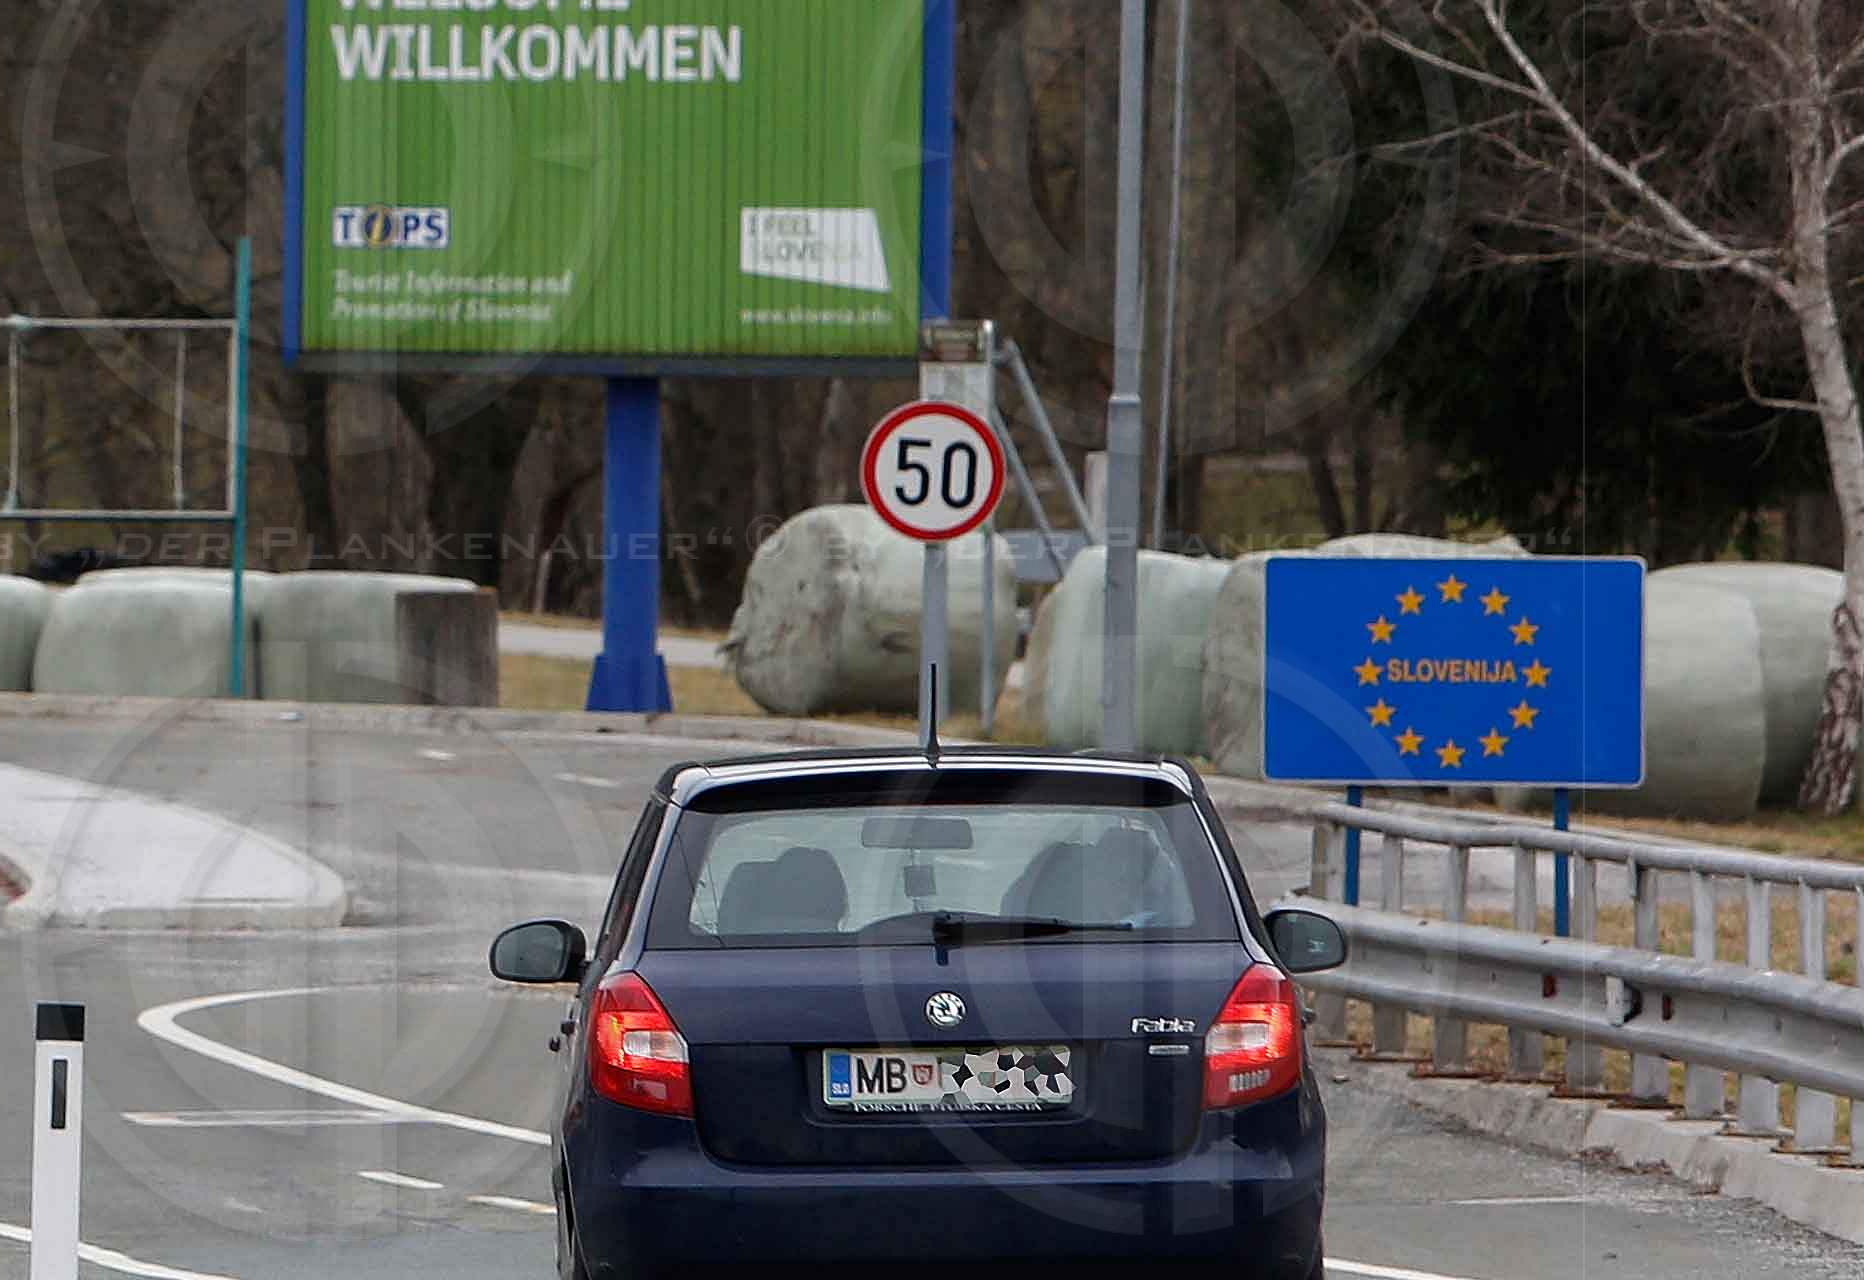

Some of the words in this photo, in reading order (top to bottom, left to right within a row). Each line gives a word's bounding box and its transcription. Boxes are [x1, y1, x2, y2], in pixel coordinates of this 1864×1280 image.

[332, 24, 742, 81] WILLKOMMEN
[895, 438, 977, 509] 50
[1387, 658, 1517, 683] SLOVENIJA
[856, 1057, 908, 1094] MB
